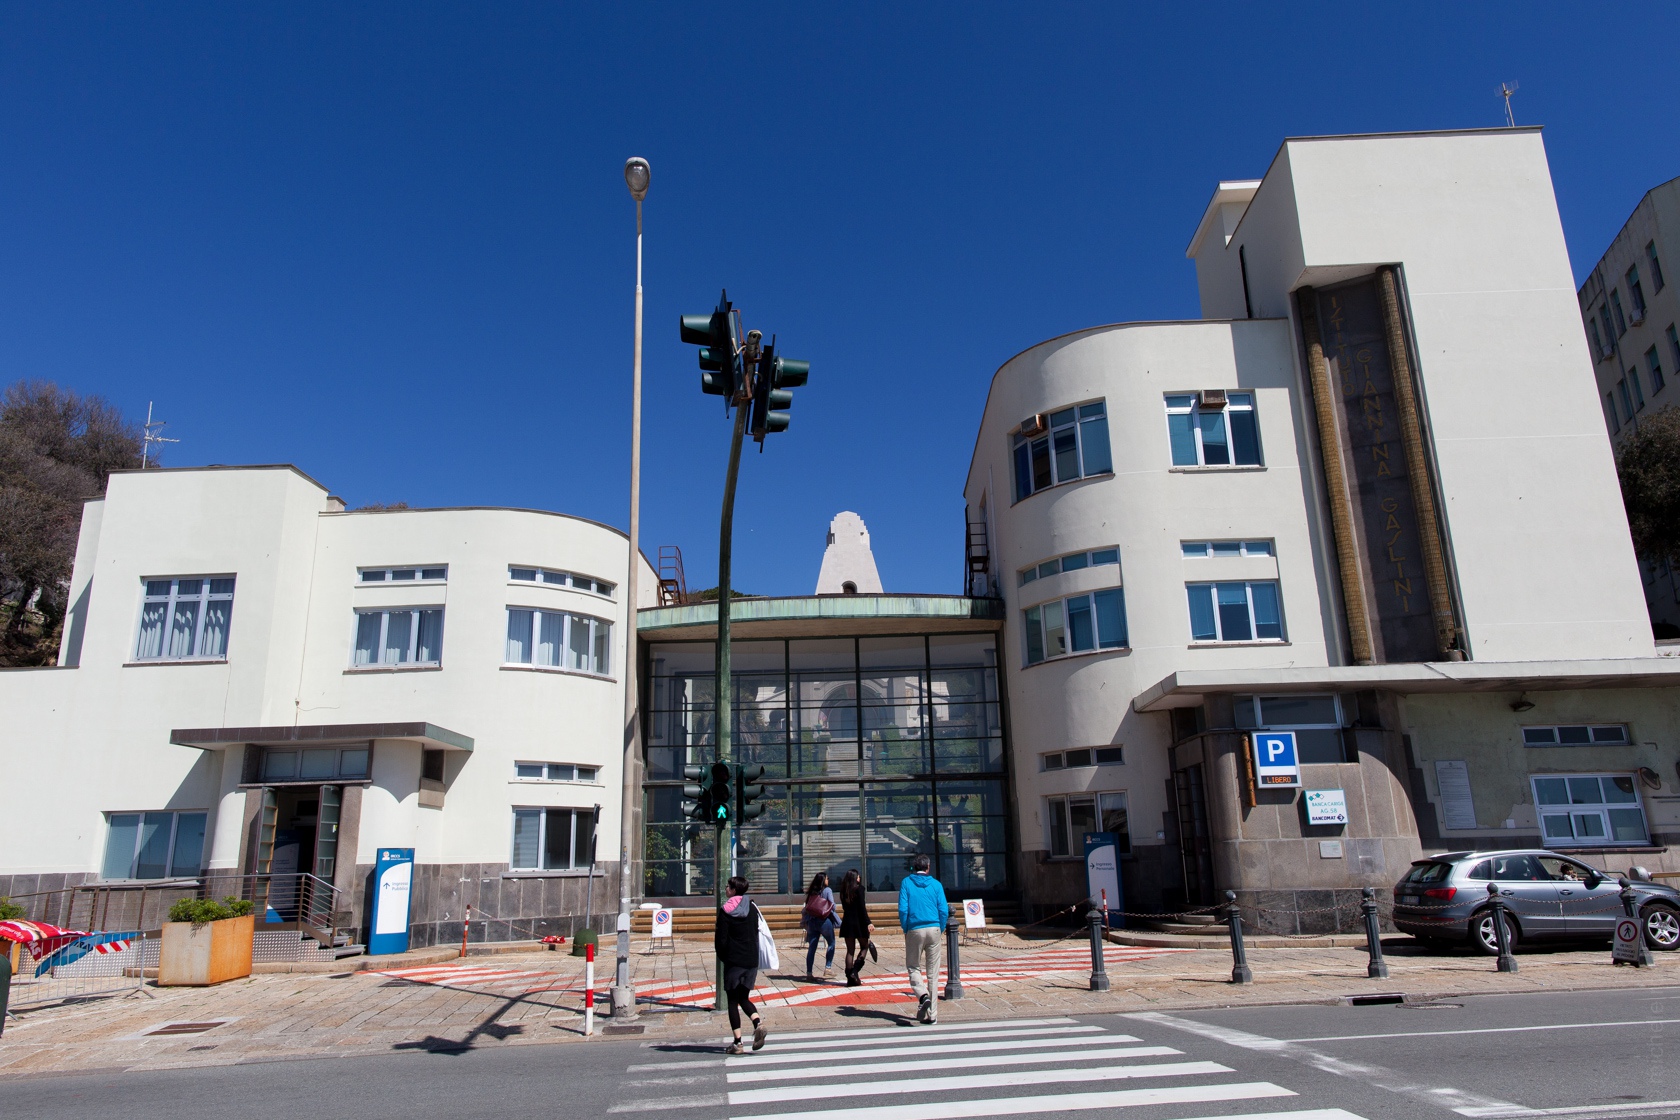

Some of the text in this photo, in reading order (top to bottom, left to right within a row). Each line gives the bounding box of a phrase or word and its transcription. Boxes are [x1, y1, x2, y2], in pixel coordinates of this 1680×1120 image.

[1330, 296, 1356, 396] ISTITUTO
[1356, 348, 1412, 613] GIANNINA GASLINI
[1268, 740, 1284, 761] P
